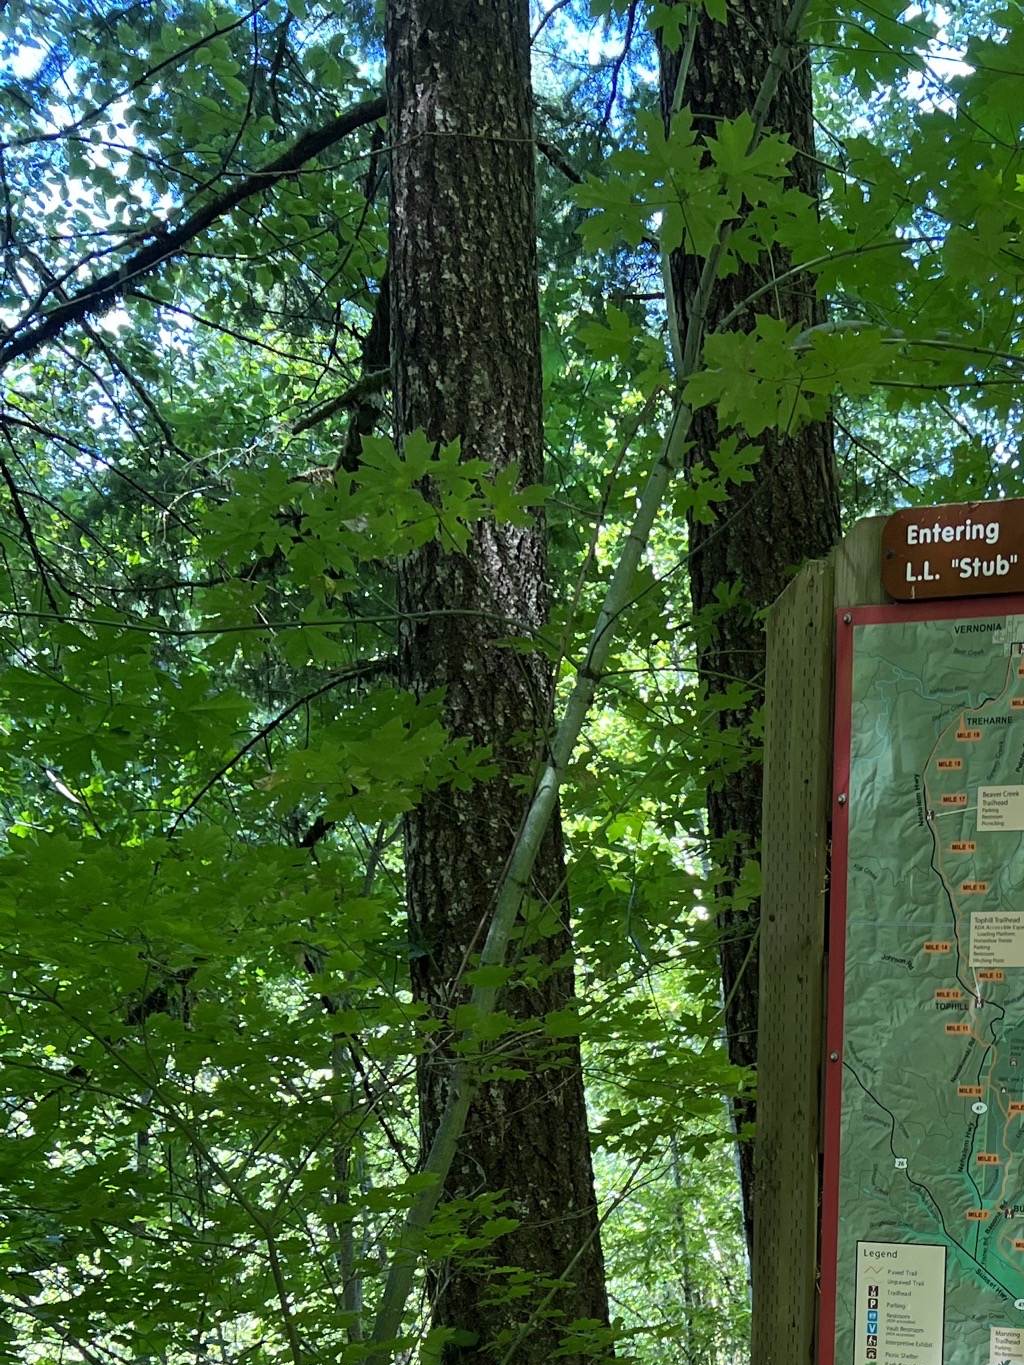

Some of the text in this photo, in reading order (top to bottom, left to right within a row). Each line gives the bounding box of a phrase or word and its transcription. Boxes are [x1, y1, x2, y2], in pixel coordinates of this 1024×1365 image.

[907, 519, 999, 545] Entering
[906, 560, 940, 582] L.L.
[951, 554, 1018, 578] "Stub"
[954, 622, 1003, 634] VERNONIA
[967, 716, 1013, 726] TREHARNE
[1002, 790, 1020, 798] Creek
[982, 799, 1009, 807] Trailhead
[974, 916, 1021, 925] Tophill Trailhead
[935, 1002, 969, 1011] TOPHILL
[863, 1248, 898, 1260] Legend
[887, 1289, 912, 1297] Trailhead
[886, 1302, 906, 1311] Parking
[995, 1330, 1021, 1340] Manning
[995, 1337, 1021, 1346] Trailhead
[900, 1352, 919, 1360] Shelter
